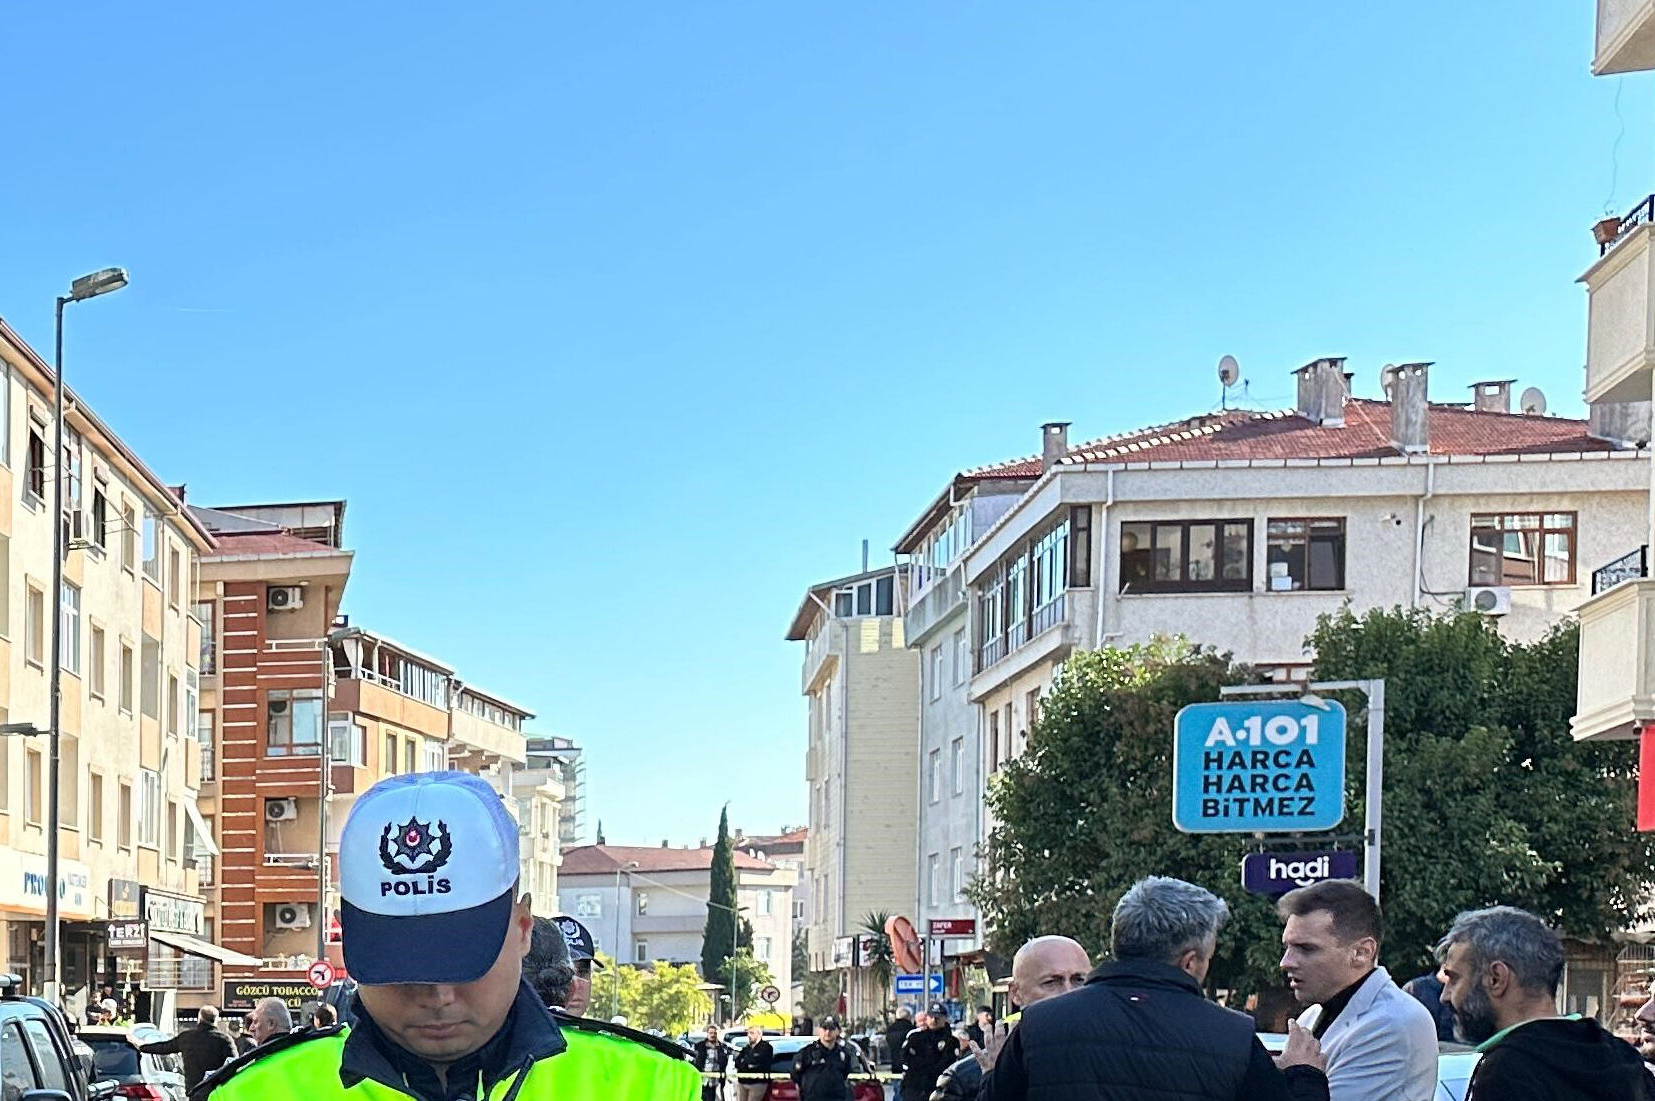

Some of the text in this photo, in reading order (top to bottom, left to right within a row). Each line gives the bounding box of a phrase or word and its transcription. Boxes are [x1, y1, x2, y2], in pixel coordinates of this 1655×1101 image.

[1203, 748, 1316, 771] HARCA
[1202, 772, 1315, 794] HARCA
[1269, 855, 1330, 882] hadi
[236, 985, 319, 996] GÖZCÜ TOBACCO
